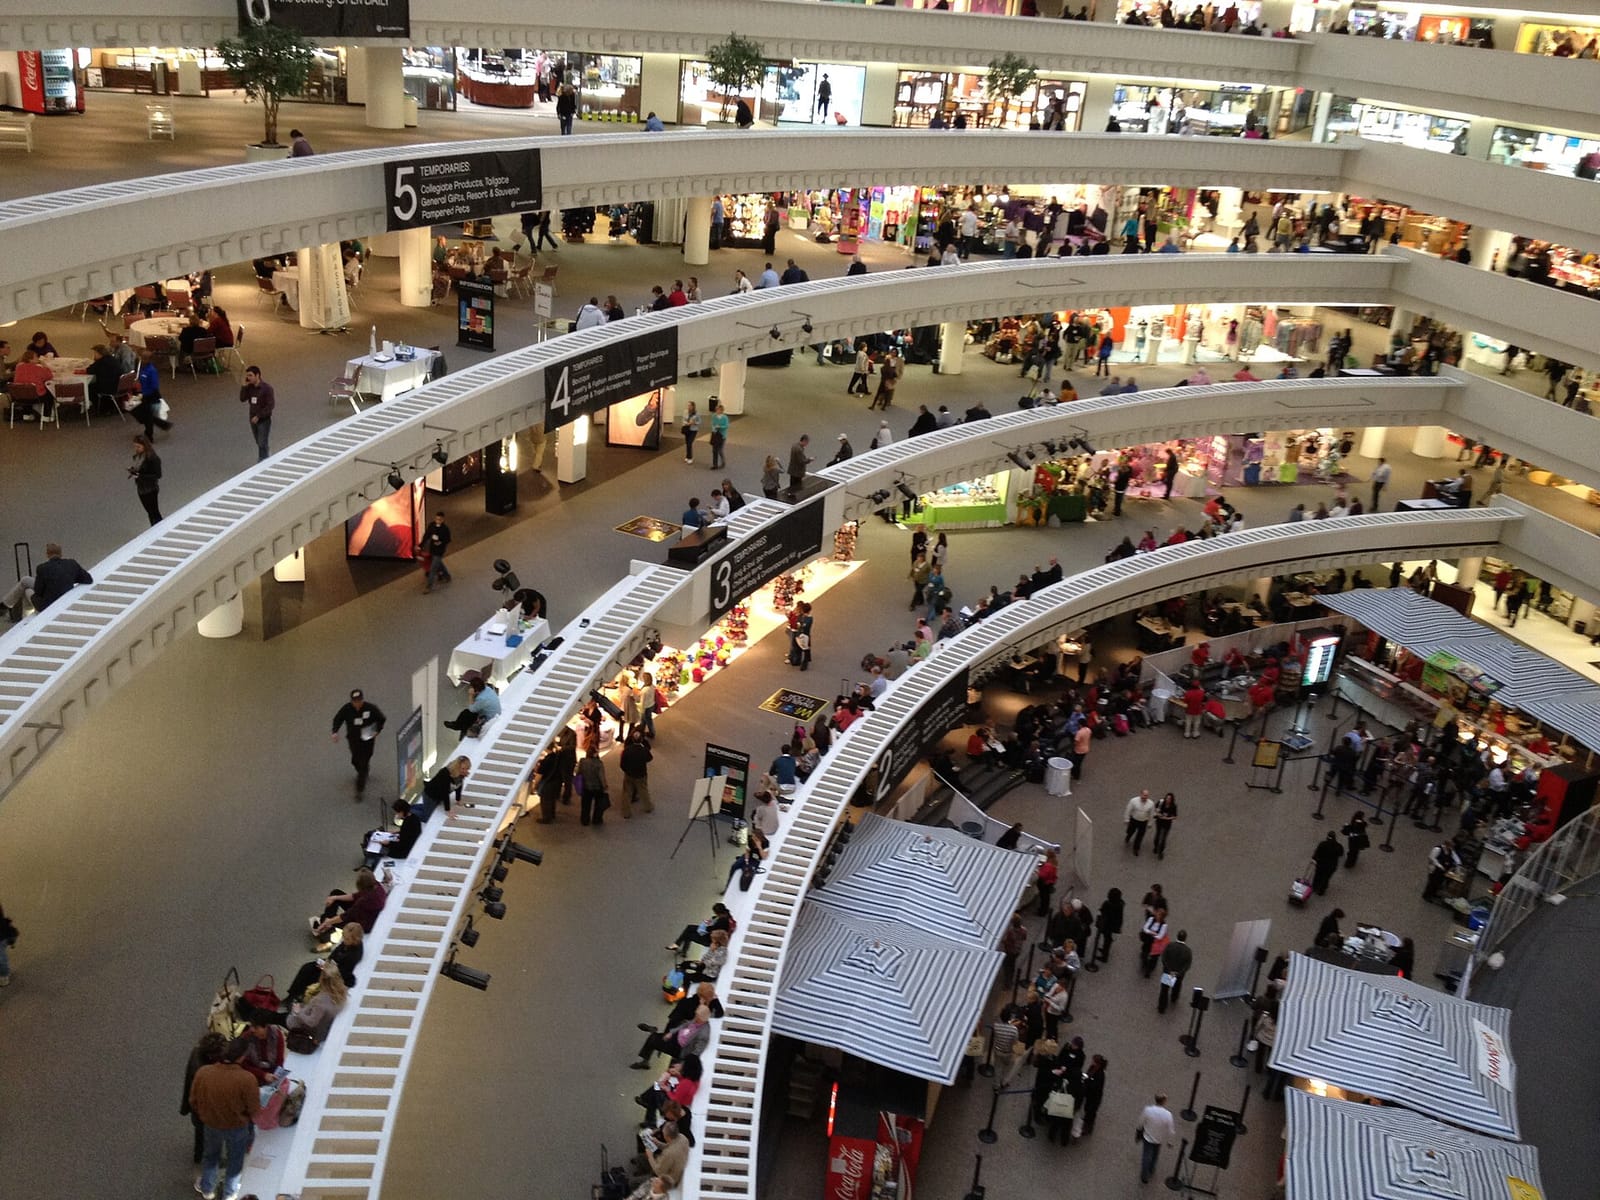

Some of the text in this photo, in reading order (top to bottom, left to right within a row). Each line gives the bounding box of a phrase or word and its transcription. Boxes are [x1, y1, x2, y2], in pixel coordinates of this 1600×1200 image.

[393, 166, 418, 222] 5
[420, 182, 453, 195] Collegiate
[485, 176, 510, 188] Tailgate
[421, 194, 447, 207] General
[466, 190, 489, 200] Resort
[489, 188, 495, 198] &
[494, 187, 520, 198] Souvenir
[421, 205, 470, 220] Pampered Pets
[550, 365, 571, 417] 4
[714, 560, 732, 610] 3
[877, 748, 893, 802] 2
